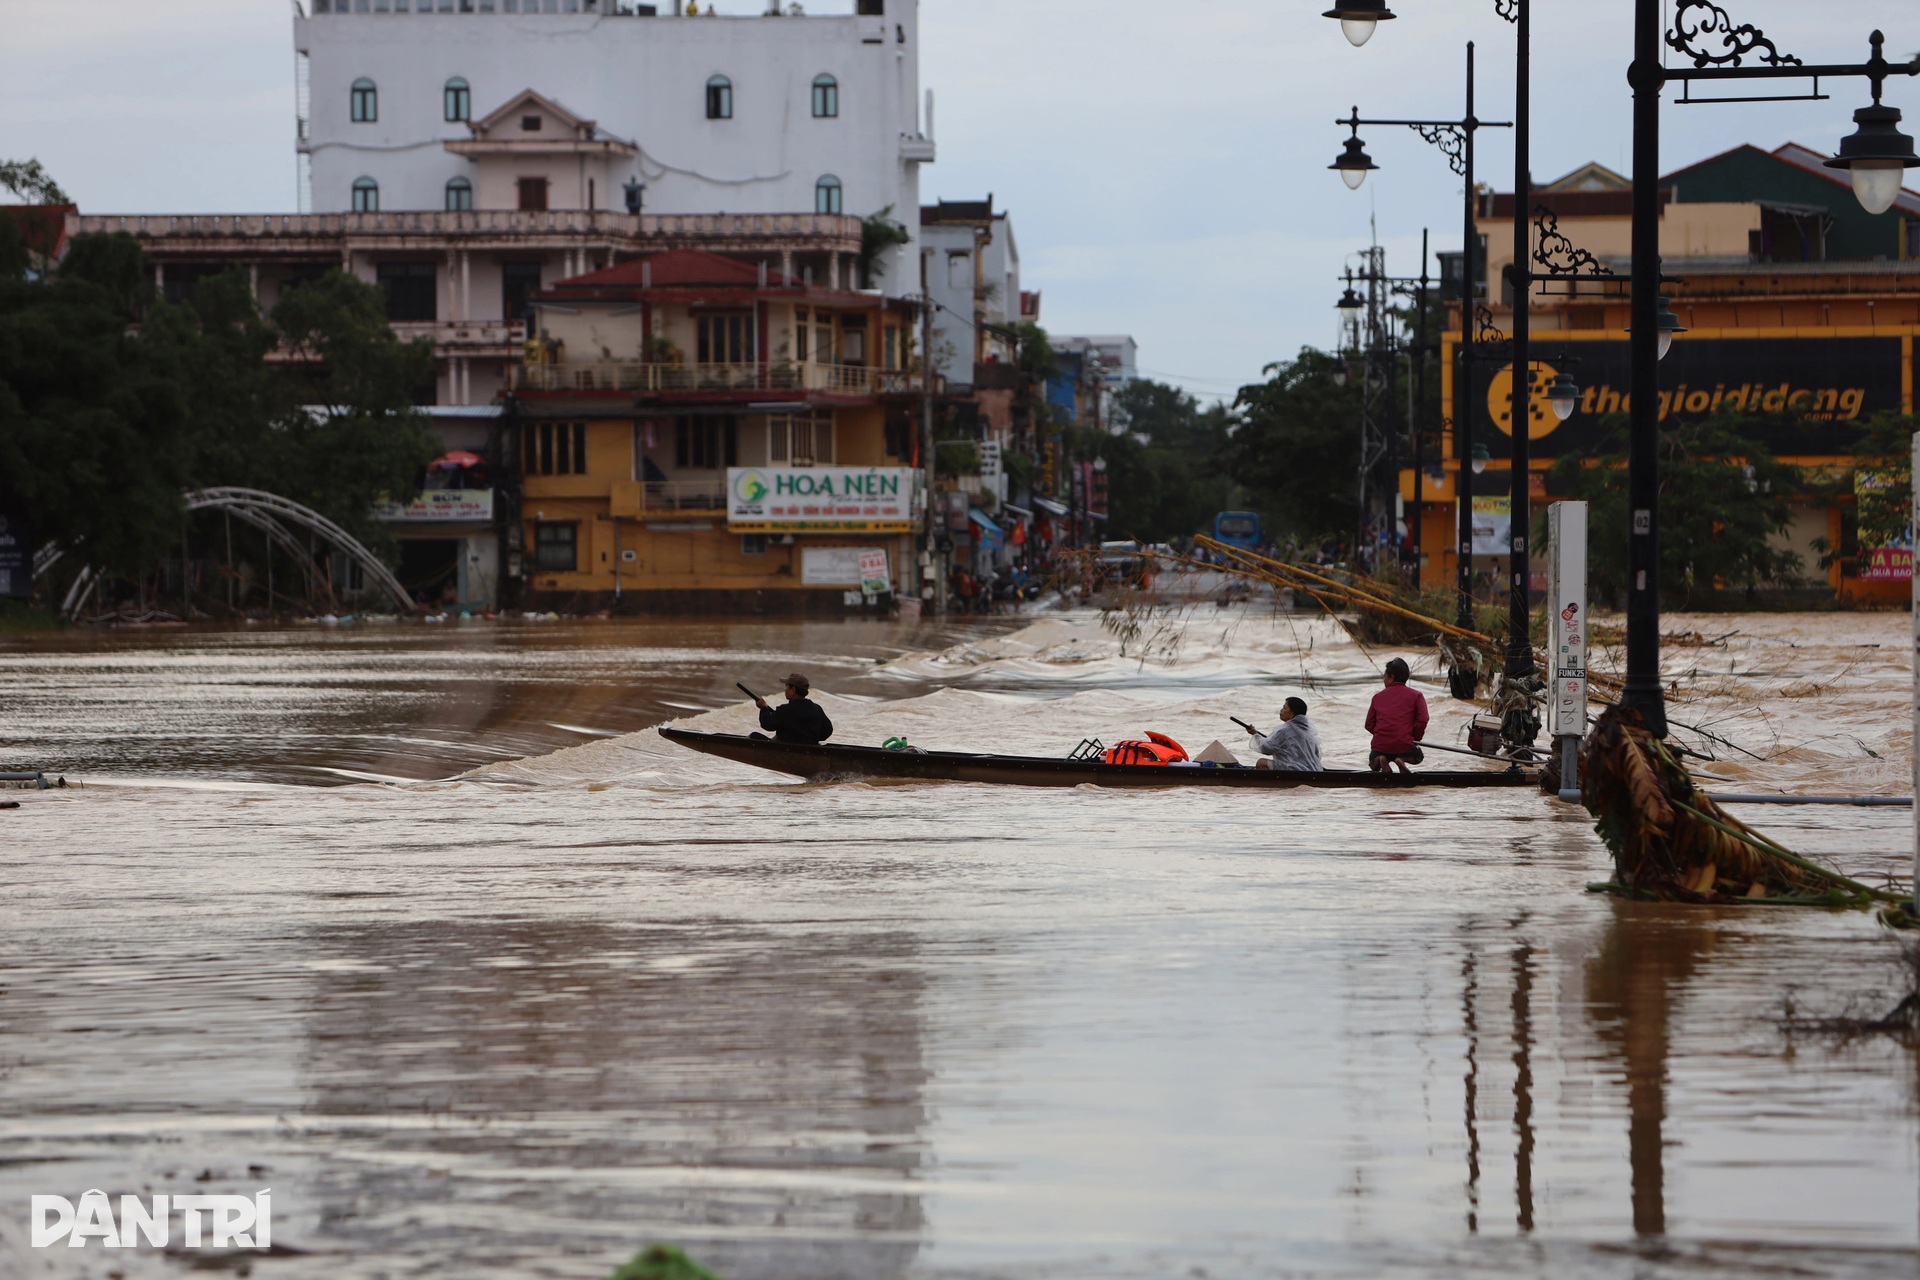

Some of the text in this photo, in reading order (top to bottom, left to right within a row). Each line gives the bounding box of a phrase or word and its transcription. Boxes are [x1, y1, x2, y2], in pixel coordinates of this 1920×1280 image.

[776, 474, 834, 495] HOA
[1636, 516, 1649, 528] 02
[1515, 541, 1523, 549] 03
[1558, 669, 1585, 678] FUNK25
